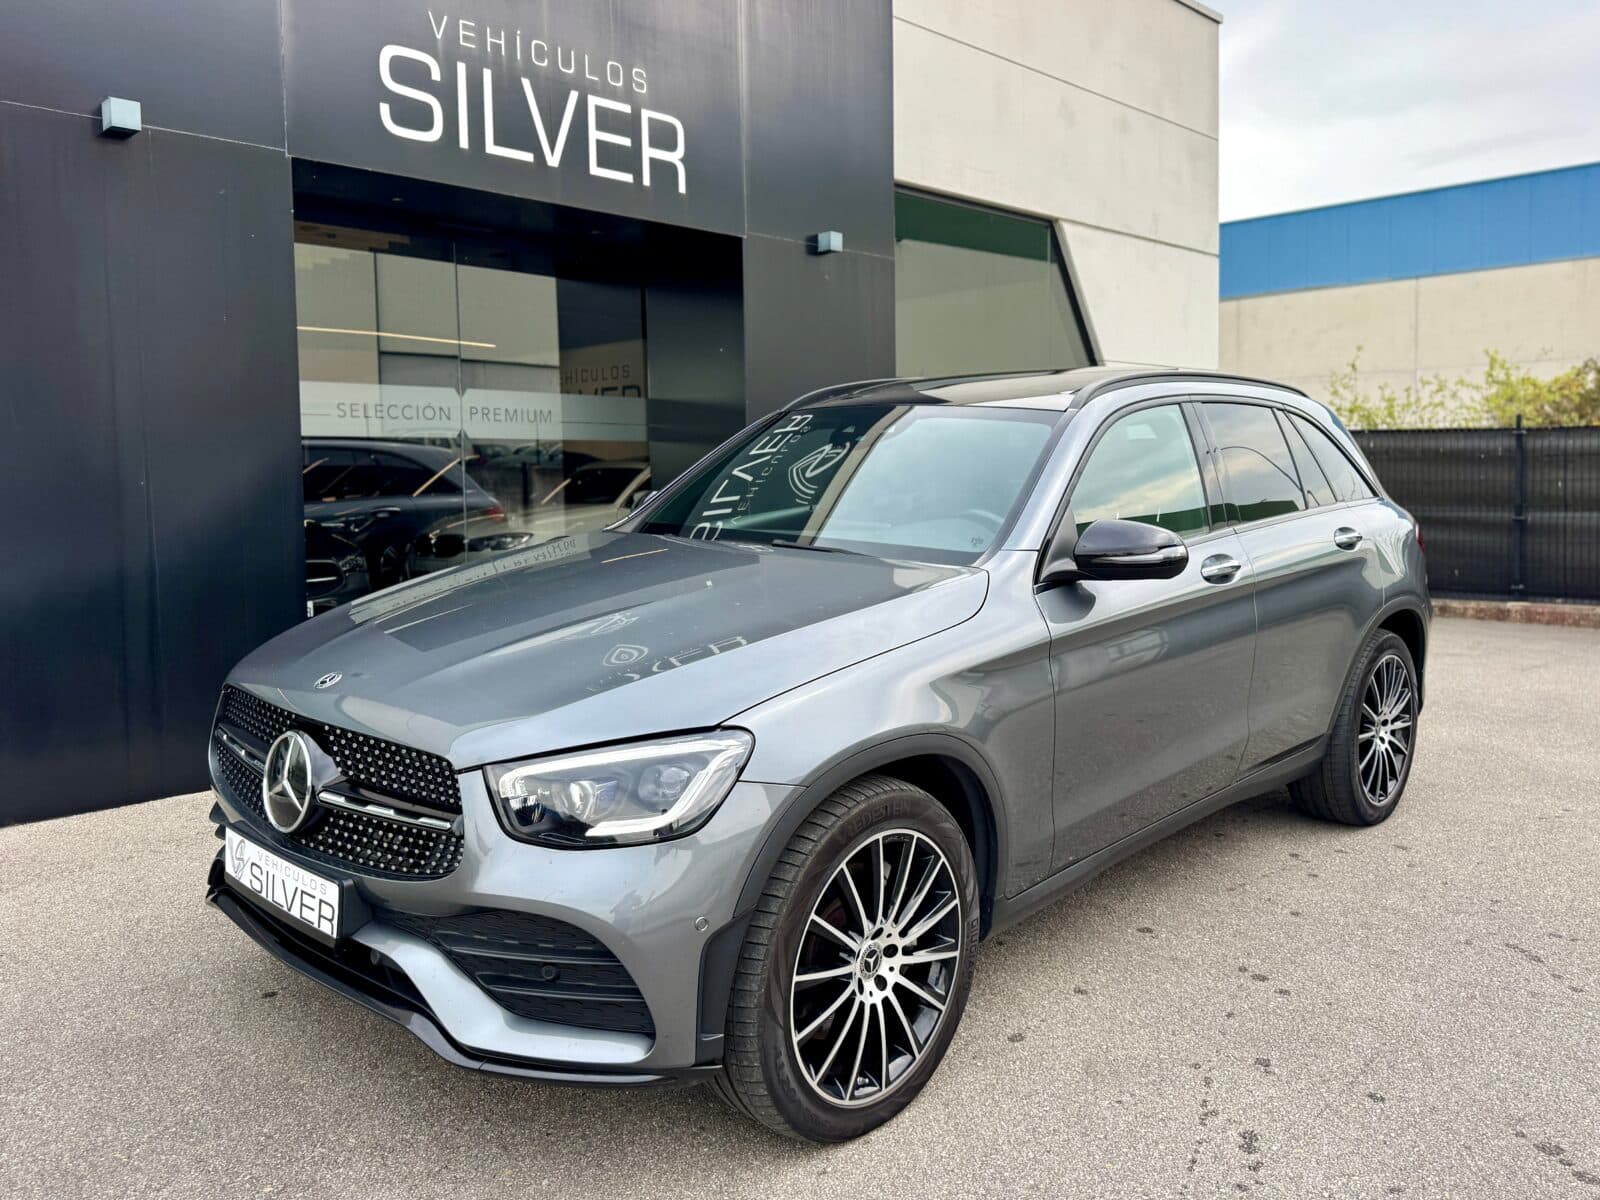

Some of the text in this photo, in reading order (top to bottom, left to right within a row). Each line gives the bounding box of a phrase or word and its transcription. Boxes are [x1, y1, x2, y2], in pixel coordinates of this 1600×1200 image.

[428, 11, 647, 94] VEHÍCULOS
[379, 44, 687, 194] SILVER
[335, 401, 552, 424] SELECCIÓN PREMIUM
[249, 862, 335, 936] SILVER
